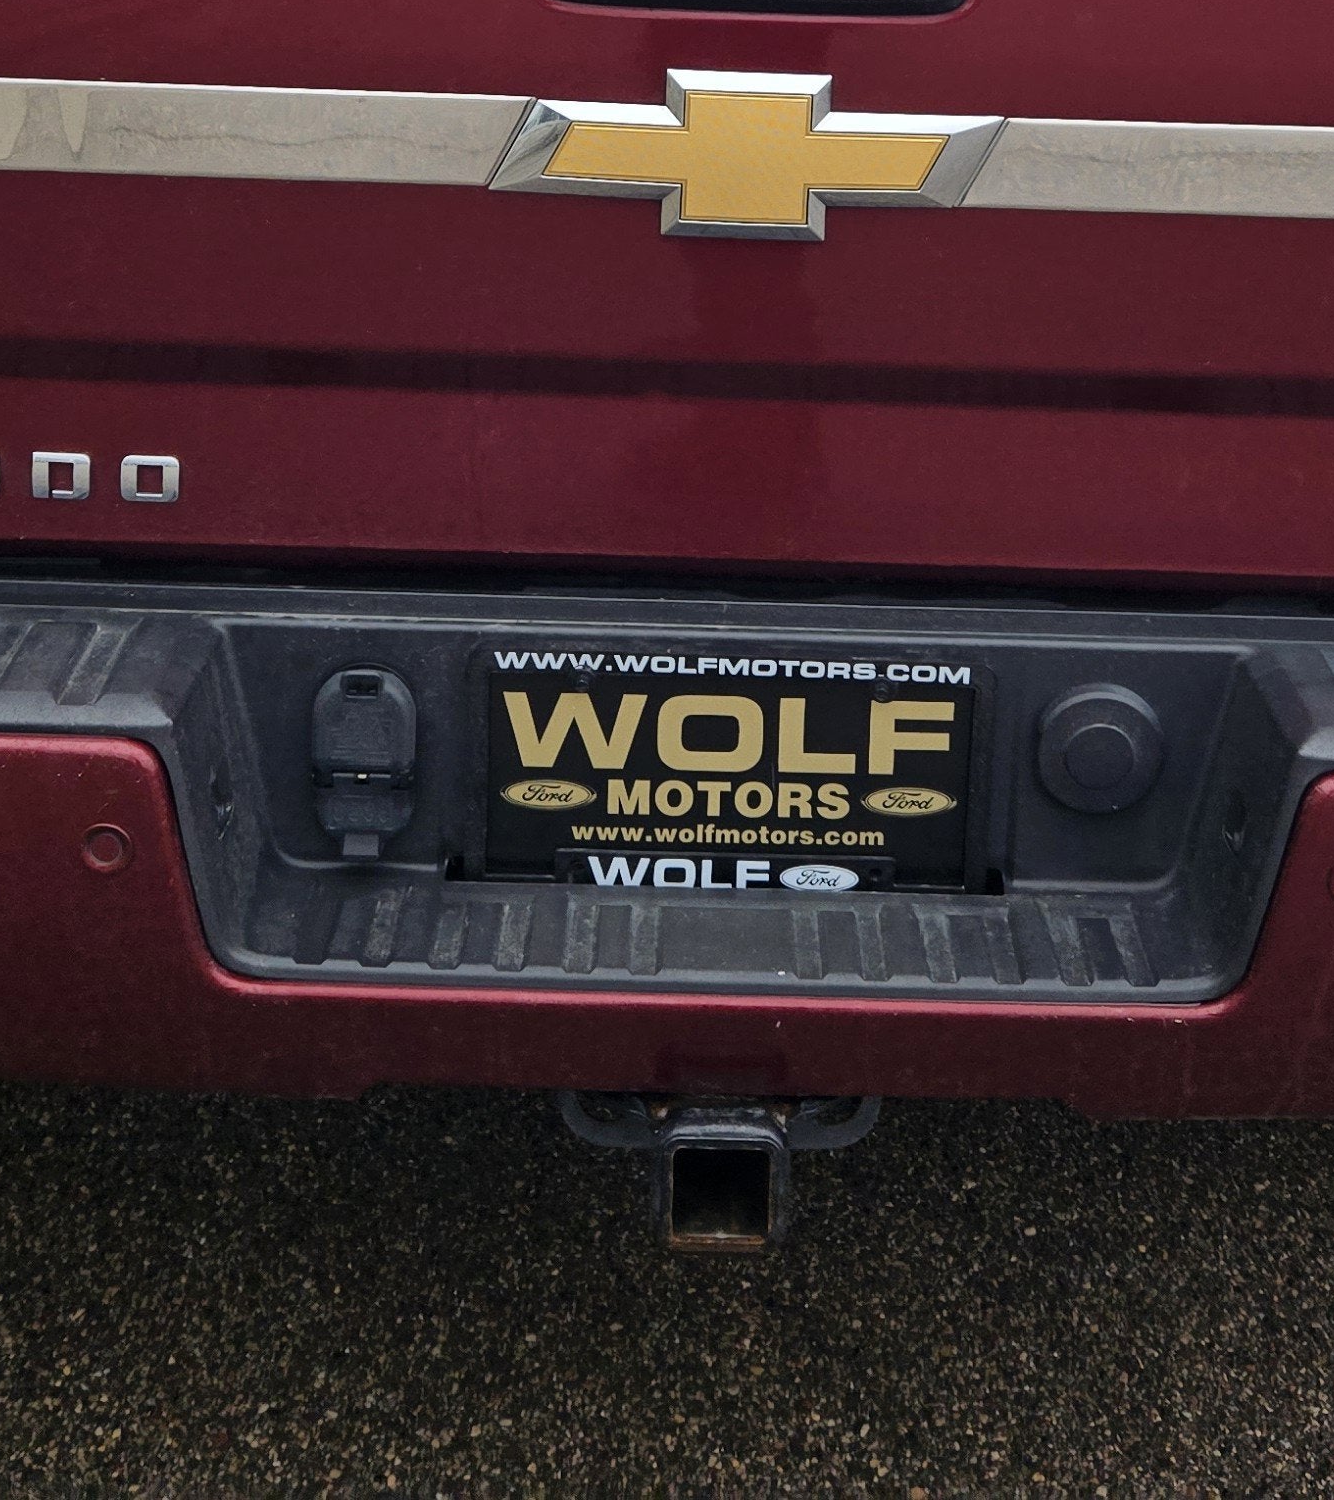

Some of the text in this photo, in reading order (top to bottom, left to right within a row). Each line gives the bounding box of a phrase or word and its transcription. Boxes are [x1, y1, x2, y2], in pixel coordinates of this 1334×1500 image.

[494, 651, 971, 685] WWW.WOLFMOTORS.COM
[502, 690, 956, 775] WOLF
[521, 778, 935, 820] Ford MOTORS Ford
[571, 822, 885, 846] www.wolfmotors.com
[587, 856, 842, 889] WOLF Ford
